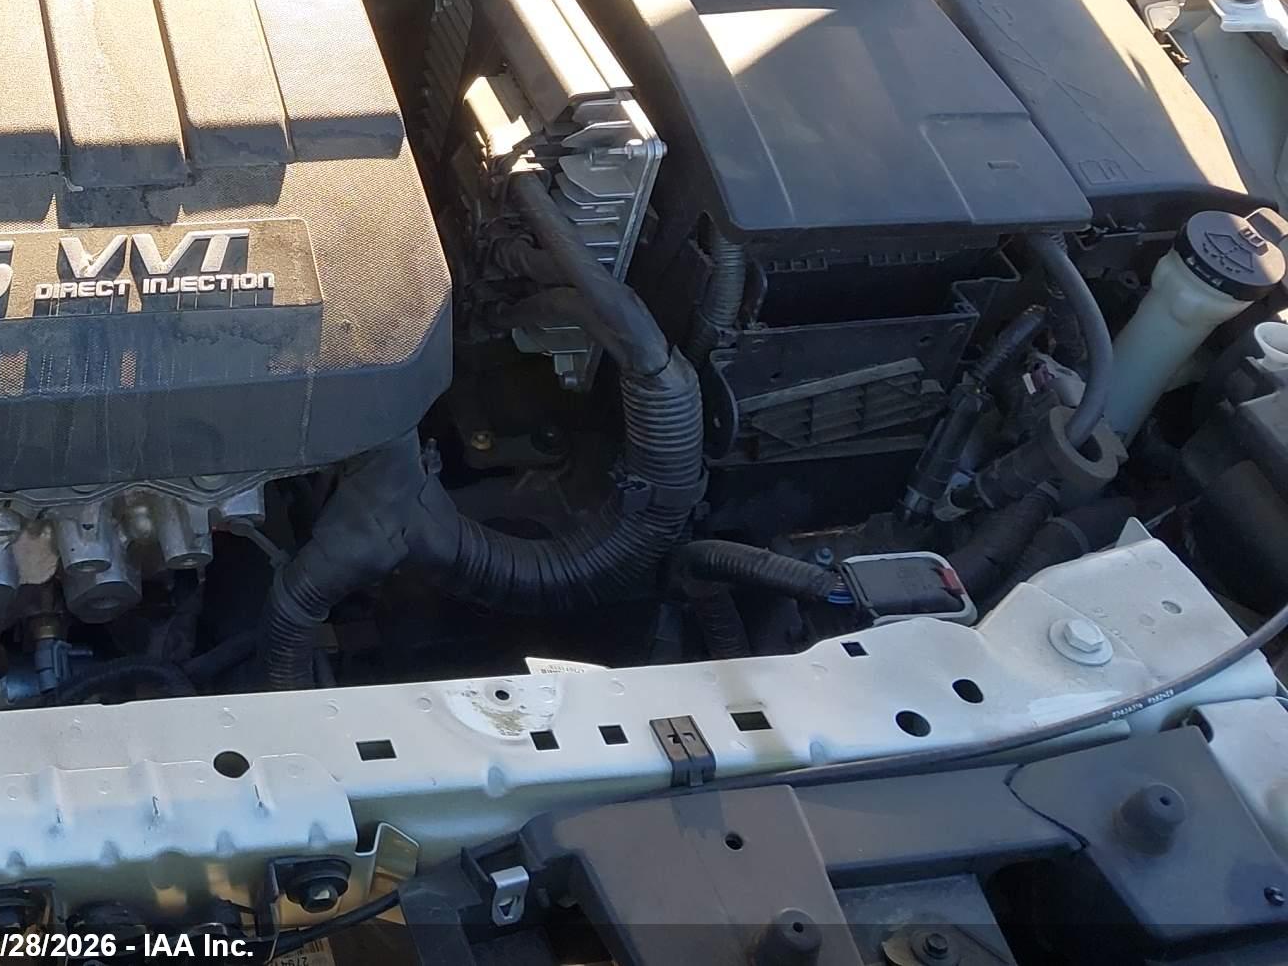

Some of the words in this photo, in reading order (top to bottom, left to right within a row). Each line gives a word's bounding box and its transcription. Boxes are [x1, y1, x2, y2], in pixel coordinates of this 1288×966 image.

[58, 228, 250, 279] VVT
[34, 279, 130, 301] DIRECT
[142, 272, 275, 296] INJECTION
